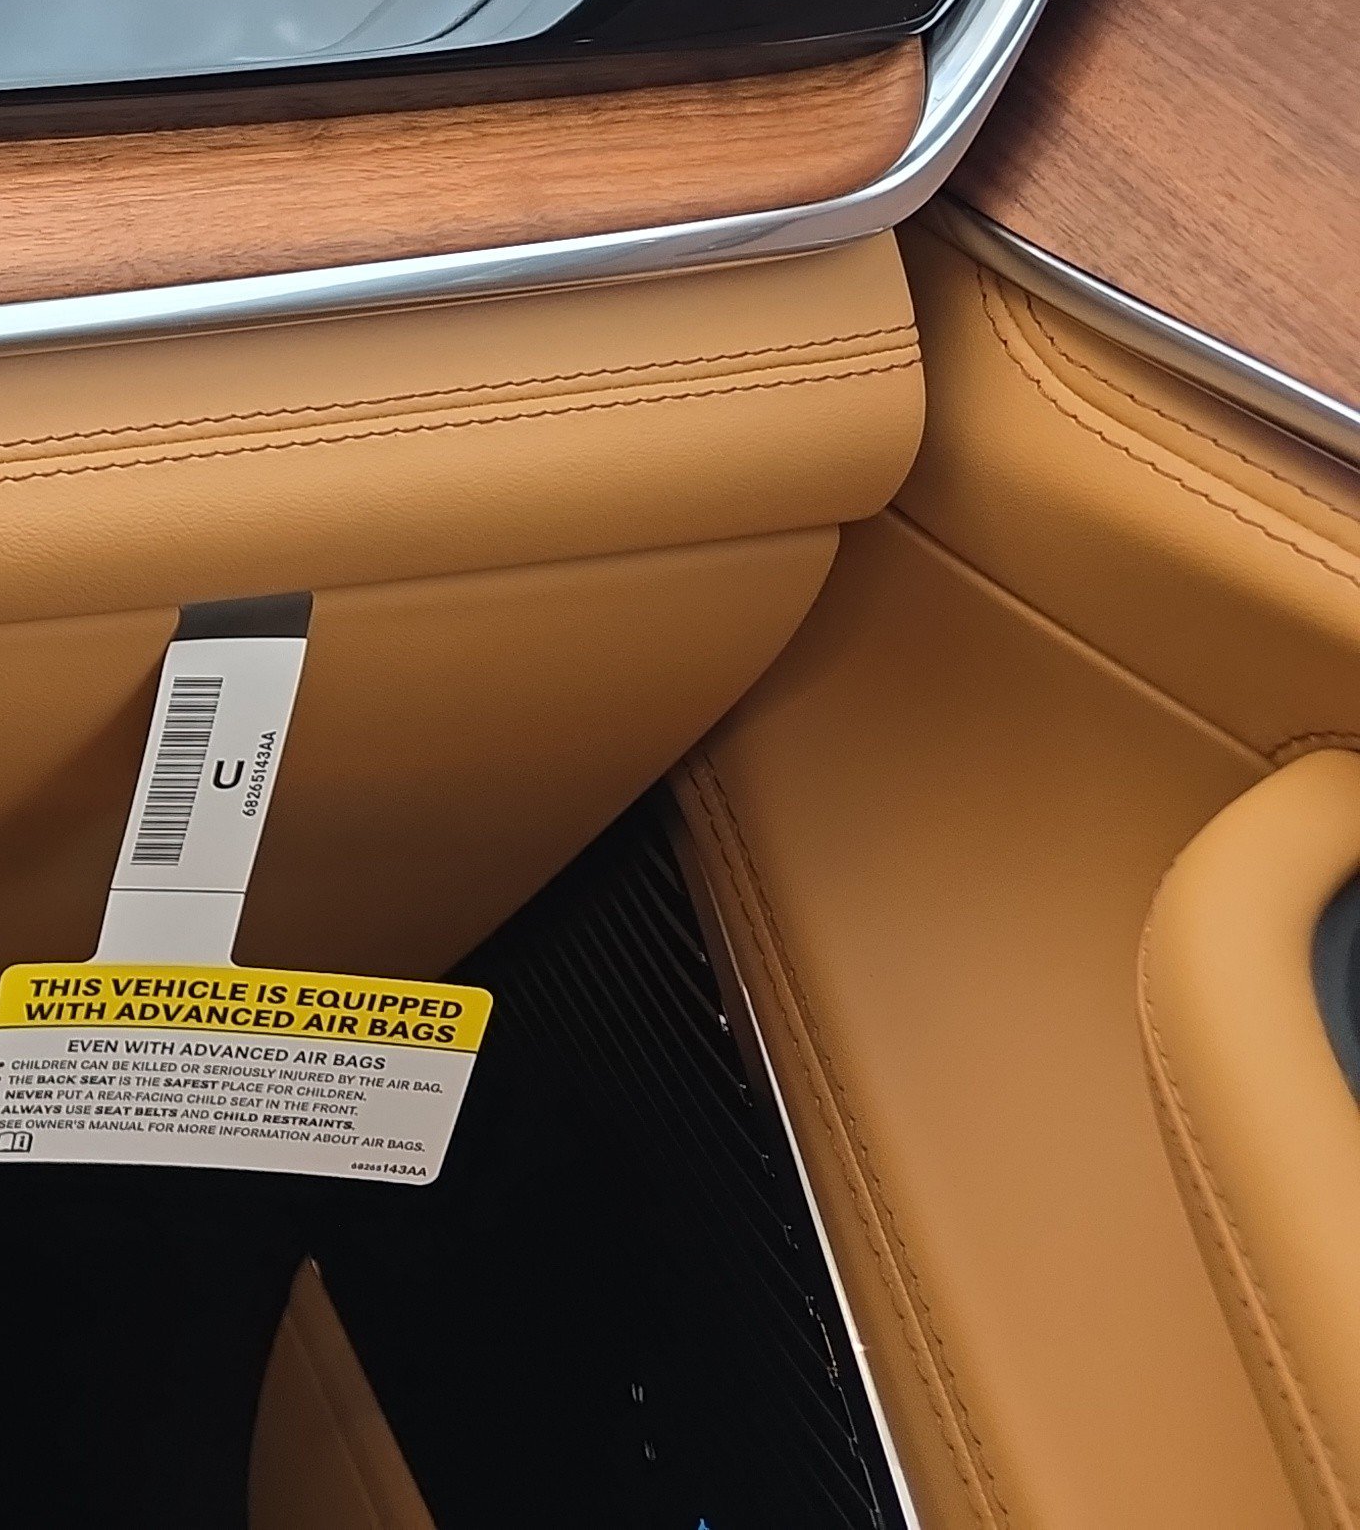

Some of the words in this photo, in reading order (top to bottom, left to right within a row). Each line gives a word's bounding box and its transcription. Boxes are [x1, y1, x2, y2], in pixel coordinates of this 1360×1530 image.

[242, 731, 277, 817] 68265143AA
[30, 978, 102, 997] THIS
[111, 978, 248, 1002] VEHICLE
[256, 984, 287, 1004] IS
[297, 987, 462, 1019] EQUIPPED
[25, 1002, 106, 1021] WITH
[115, 1003, 294, 1028] ADVANCED
[302, 1013, 359, 1034] AIR
[367, 1018, 456, 1043] BAGS
[67, 1039, 118, 1053] EVEN
[125, 1040, 174, 1055] WITH
[180, 1042, 288, 1061] ADVANCED
[293, 1050, 327, 1065] AIR
[333, 1053, 386, 1069] BAGS
[8, 1075, 33, 1085] THE
[36, 1075, 76, 1085] BACK
[79, 1075, 116, 1086] SEAT
[119, 1076, 131, 1086] IS
[135, 1076, 160, 1087] THE
[163, 1078, 220, 1089] SAFEST
[221, 1081, 264, 1093] PLACE
[266, 1083, 293, 1096] FOR
[296, 1086, 367, 1101] CHILDREN.
[11, 1060, 77, 1070] CHILDREN
[80, 1060, 108, 1070] CAN
[112, 1061, 129, 1070] BE
[132, 1061, 177, 1072] KILLED
[181, 1063, 200, 1073] OR
[203, 1064, 276, 1079] SERIOUSLY
[279, 1070, 334, 1083] INJURED
[338, 1074, 356, 1085] BY
[359, 1076, 384, 1087] THE
[386, 1079, 410, 1090] AIR
[413, 1081, 443, 1094] BAG.
[1, 1105, 62, 1115] ALWAYS
[65, 1105, 92, 1115] USE
[94, 1106, 132, 1116] SEAT
[134, 1107, 178, 1118] BELTS
[180, 1108, 210, 1120] AND
[213, 1111, 258, 1122] CHILD
[262, 1114, 356, 1131] RESTRAINTS.
[4, 1089, 53, 1100] NEVER
[56, 1090, 82, 1100] PUT
[84, 1090, 94, 1100] A
[97, 1090, 183, 1103] REAR-FACING
[186, 1094, 227, 1106] CHILD
[230, 1096, 263, 1108] SEAT
[265, 1099, 280, 1109] IN
[283, 1100, 309, 1112] THE
[312, 1102, 359, 1116] FRONT.
[25, 1119, 85, 1130] OWNER'S
[88, 1120, 144, 1132] MANUAL
[147, 1121, 174, 1133] FOR
[177, 1123, 216, 1135] MORE
[219, 1125, 310, 1142] INFORMATION
[312, 1133, 359, 1146] ABOUT
[361, 1137, 384, 1148] AIR
[387, 1139, 426, 1152] BAGS.
